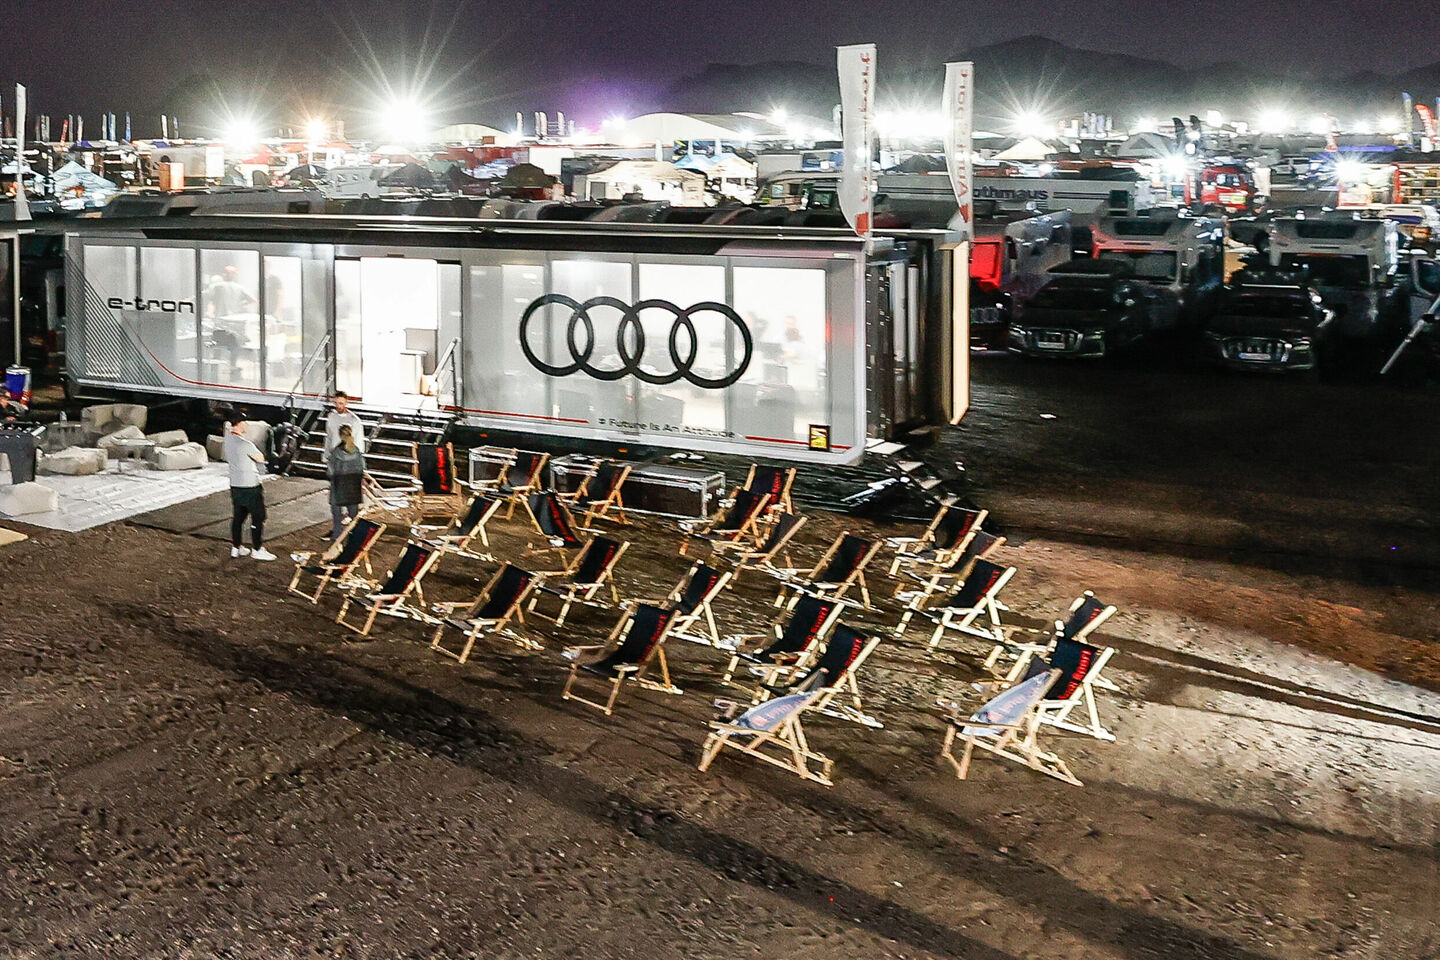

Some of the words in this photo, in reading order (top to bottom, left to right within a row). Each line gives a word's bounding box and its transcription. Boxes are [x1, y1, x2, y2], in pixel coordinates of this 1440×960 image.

[108, 296, 195, 313] e-tron
[609, 418, 647, 430] Future
[663, 424, 679, 432] An
